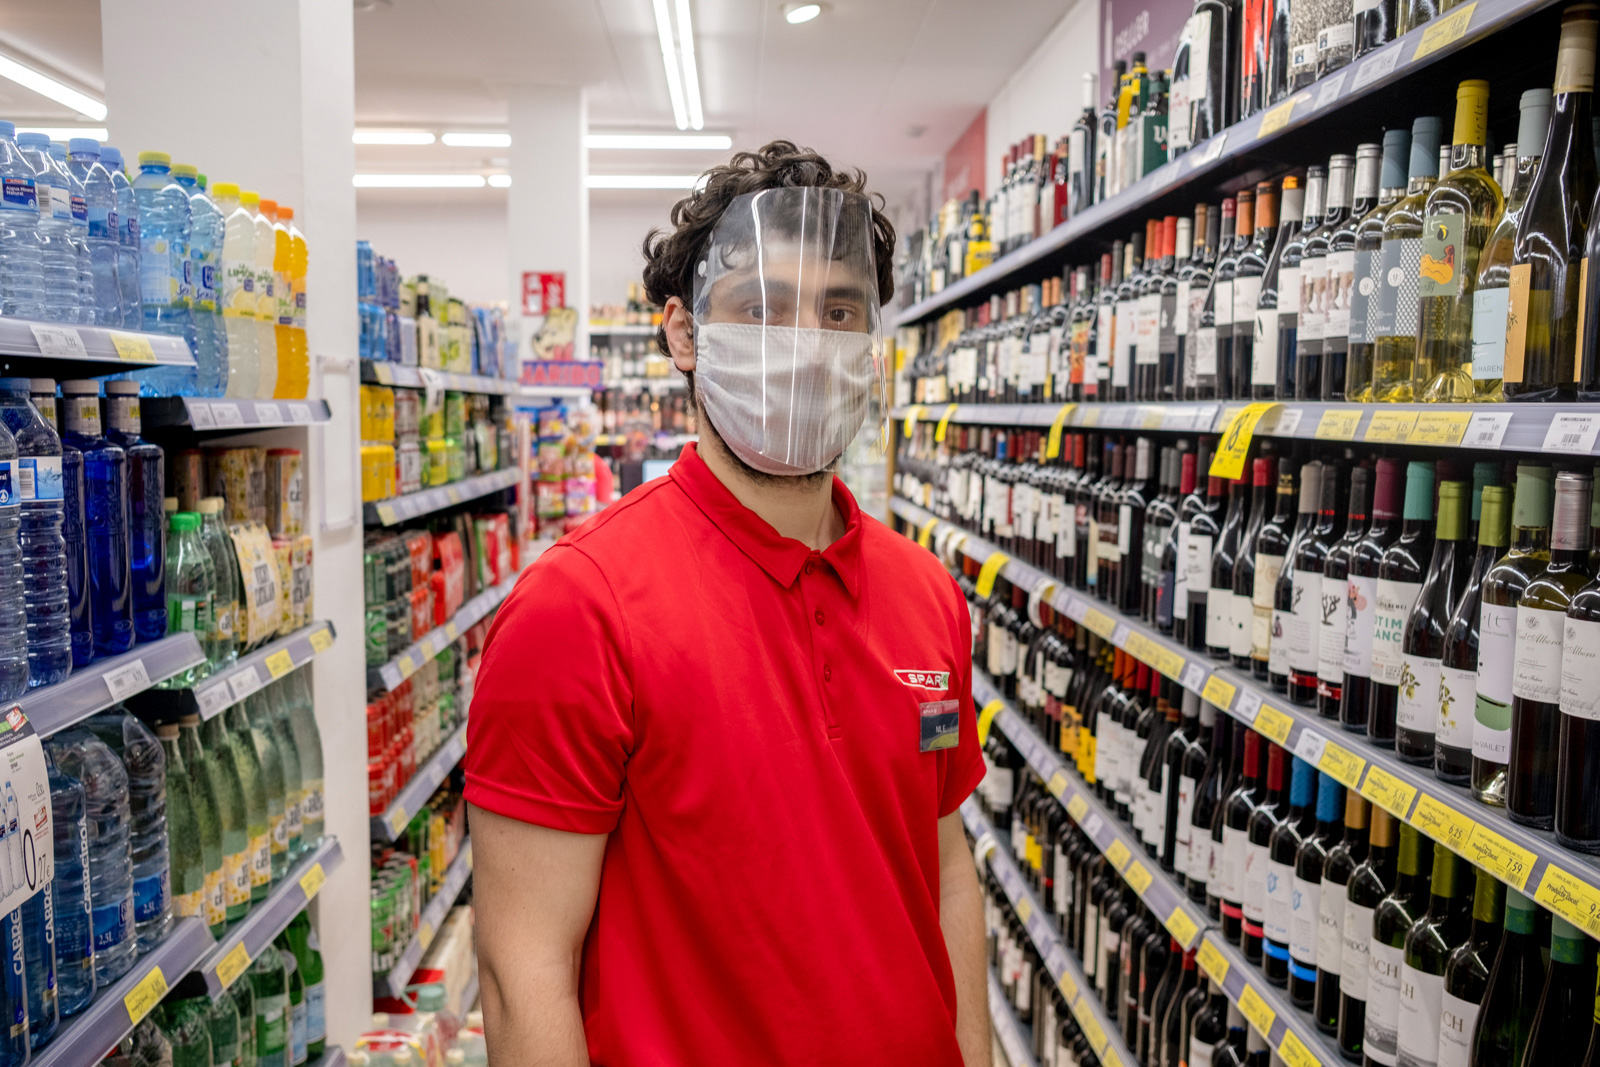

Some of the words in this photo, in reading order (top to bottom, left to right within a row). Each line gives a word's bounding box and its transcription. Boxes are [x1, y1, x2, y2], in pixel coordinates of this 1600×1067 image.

[519, 364, 600, 386] HARIBO
[1479, 364, 1503, 373] MAREN
[1374, 629, 1402, 643] ANC
[908, 673, 941, 686] SPAR
[1479, 741, 1506, 752] VAILET
[1448, 824, 1462, 840] 6,25
[1471, 842, 1488, 856] Producte
[1506, 858, 1523, 875] 7,59
[1546, 883, 1567, 898] Producte
[1565, 894, 1579, 906] Local
[1589, 903, 1600, 920] 9,2
[99, 931, 113, 945] 2,5L
[1370, 956, 1399, 979] ACH
[1442, 1010, 1464, 1033] CH
